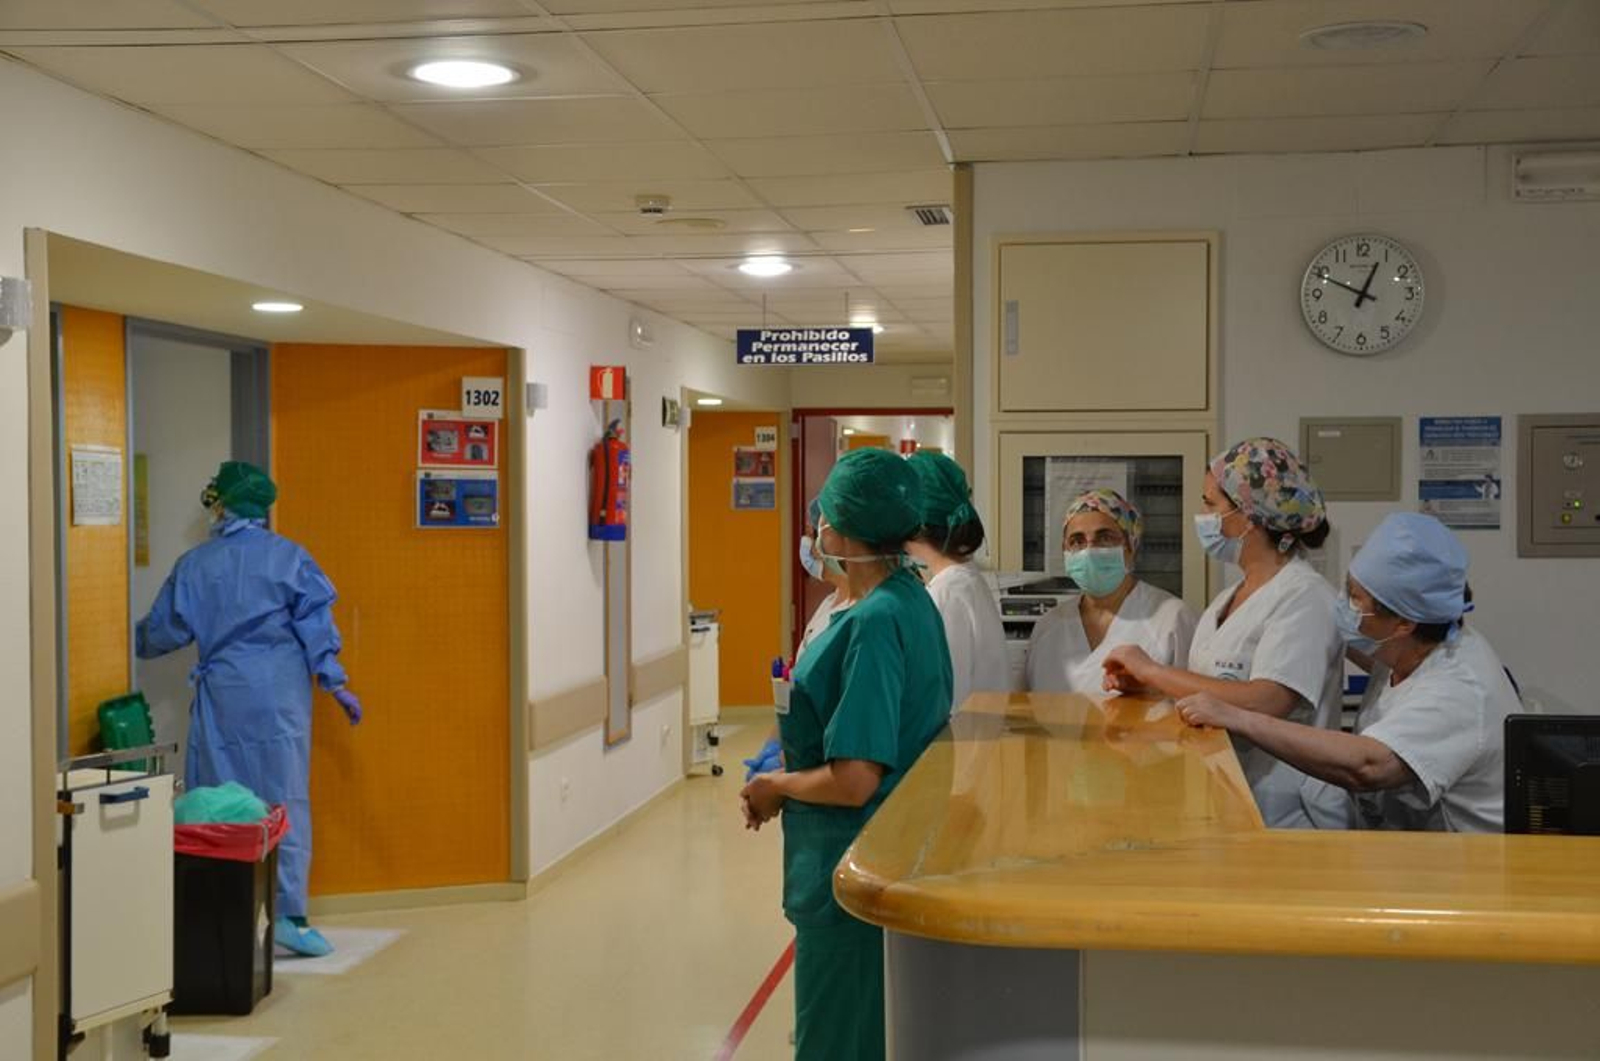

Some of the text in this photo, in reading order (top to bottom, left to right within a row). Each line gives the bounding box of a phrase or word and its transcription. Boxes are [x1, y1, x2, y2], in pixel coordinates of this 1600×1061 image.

[1335, 249, 1347, 263] 11
[1356, 243, 1371, 258] 12
[1384, 249, 1389, 263] 1
[1397, 264, 1409, 280] 2
[1312, 288, 1323, 301] 9
[1404, 286, 1415, 301] 3
[1318, 310, 1328, 325] 8
[1395, 309, 1407, 323] 4
[760, 330, 850, 341] Prohibido
[1332, 326, 1344, 344] 7
[1355, 332, 1367, 346] 6
[1380, 326, 1390, 340] 5
[751, 342, 859, 352] Permanecer
[742, 351, 868, 363] en los Pasillos
[465, 389, 500, 407] 1302
